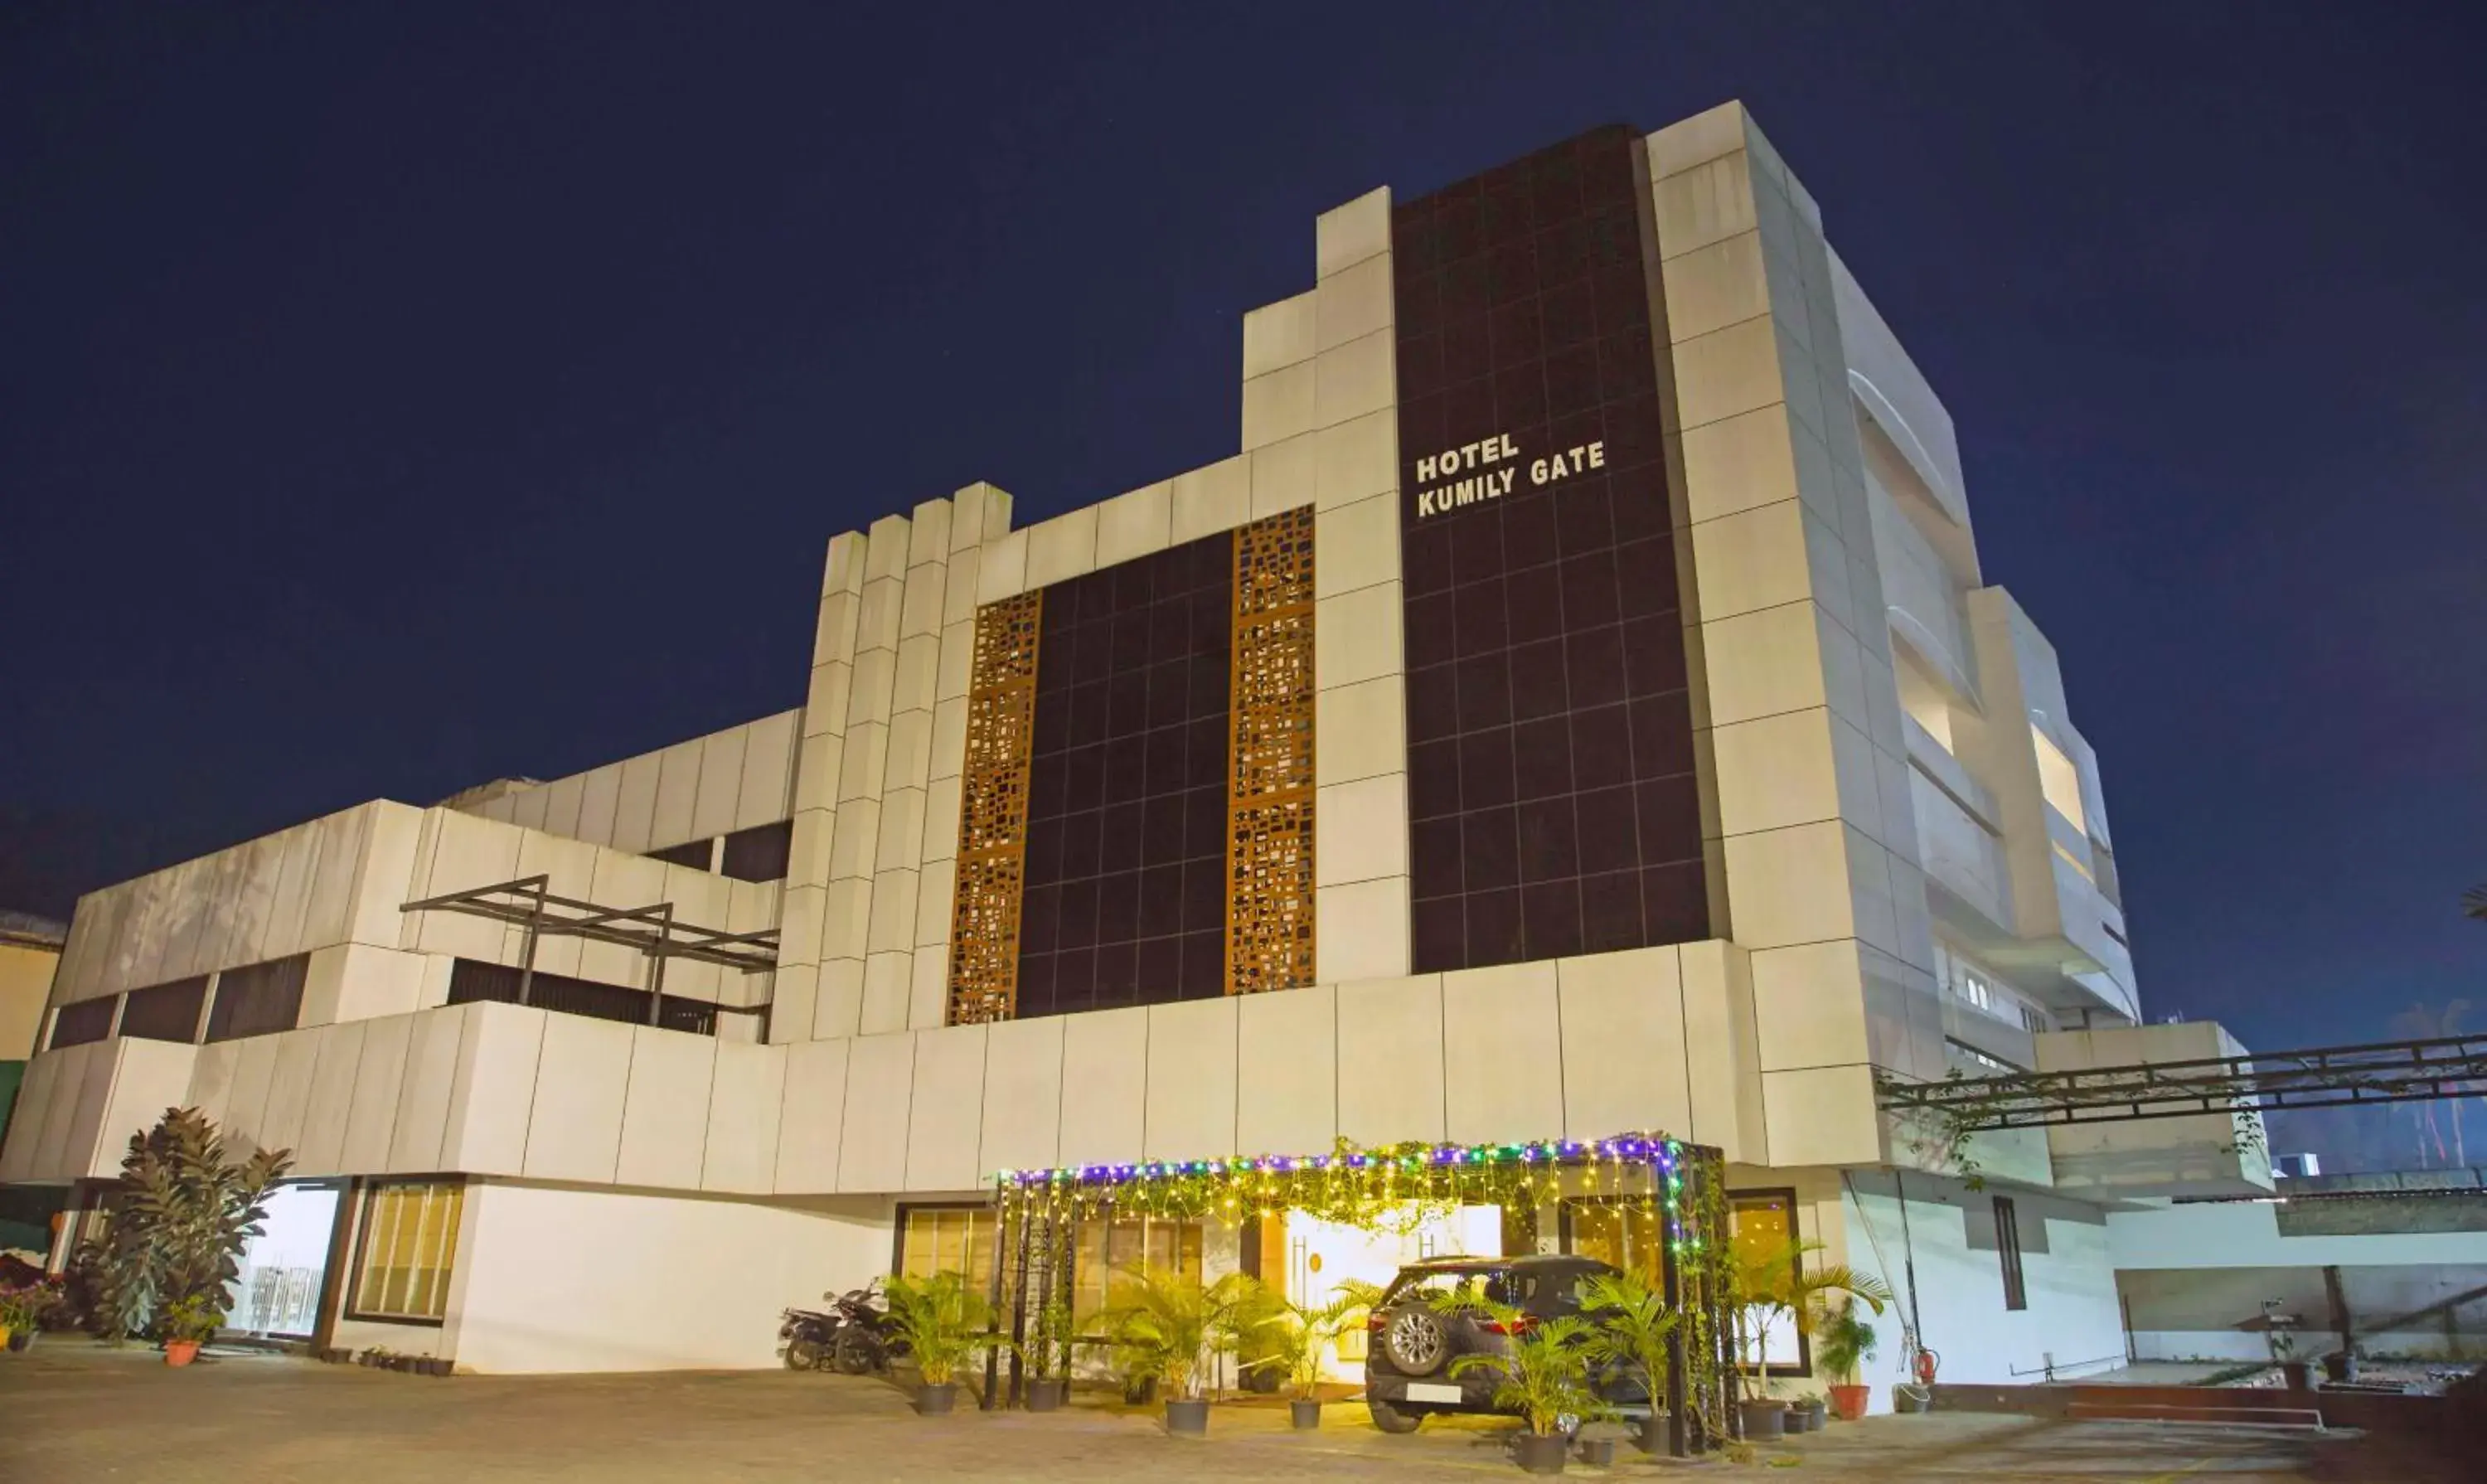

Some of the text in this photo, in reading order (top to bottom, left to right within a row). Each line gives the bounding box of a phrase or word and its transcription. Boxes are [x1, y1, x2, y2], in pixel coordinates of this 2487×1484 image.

[1417, 434, 1519, 483] HOTEL
[1418, 441, 1605, 517] KUMILY GATE
